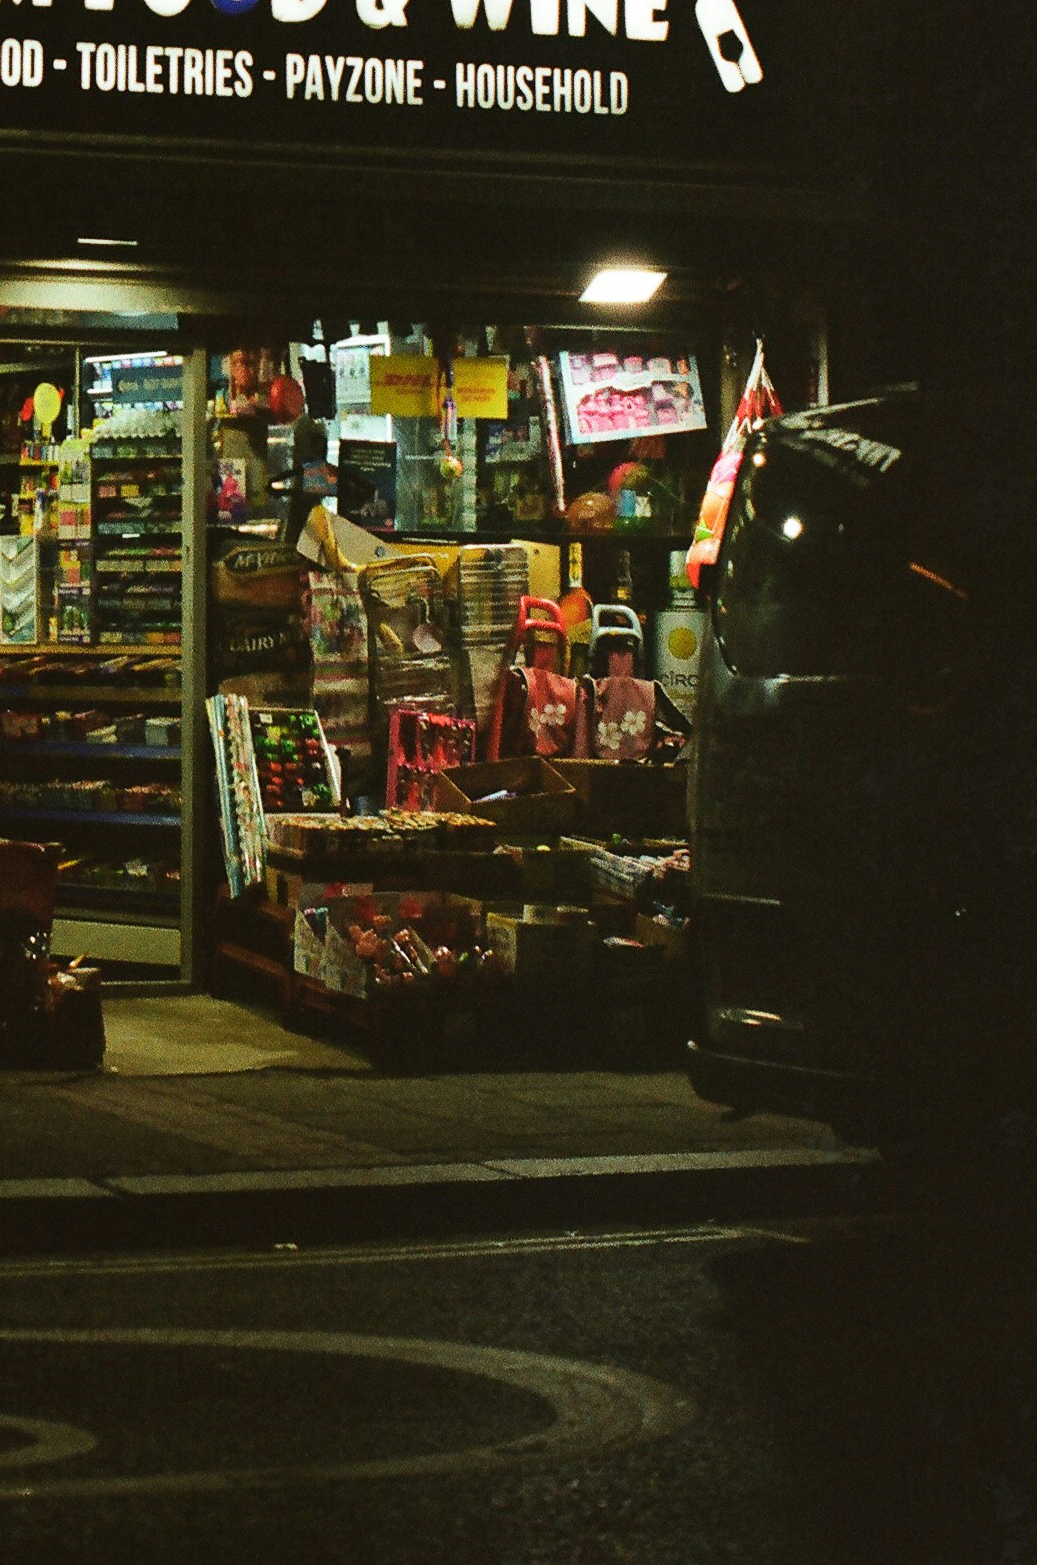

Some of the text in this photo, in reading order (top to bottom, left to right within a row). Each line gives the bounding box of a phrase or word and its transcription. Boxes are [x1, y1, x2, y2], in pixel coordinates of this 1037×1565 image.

[75, 41, 254, 98] TOILETRIES
[285, 52, 425, 106] PAYZONE
[455, 62, 629, 115] HOUSEHOLD
